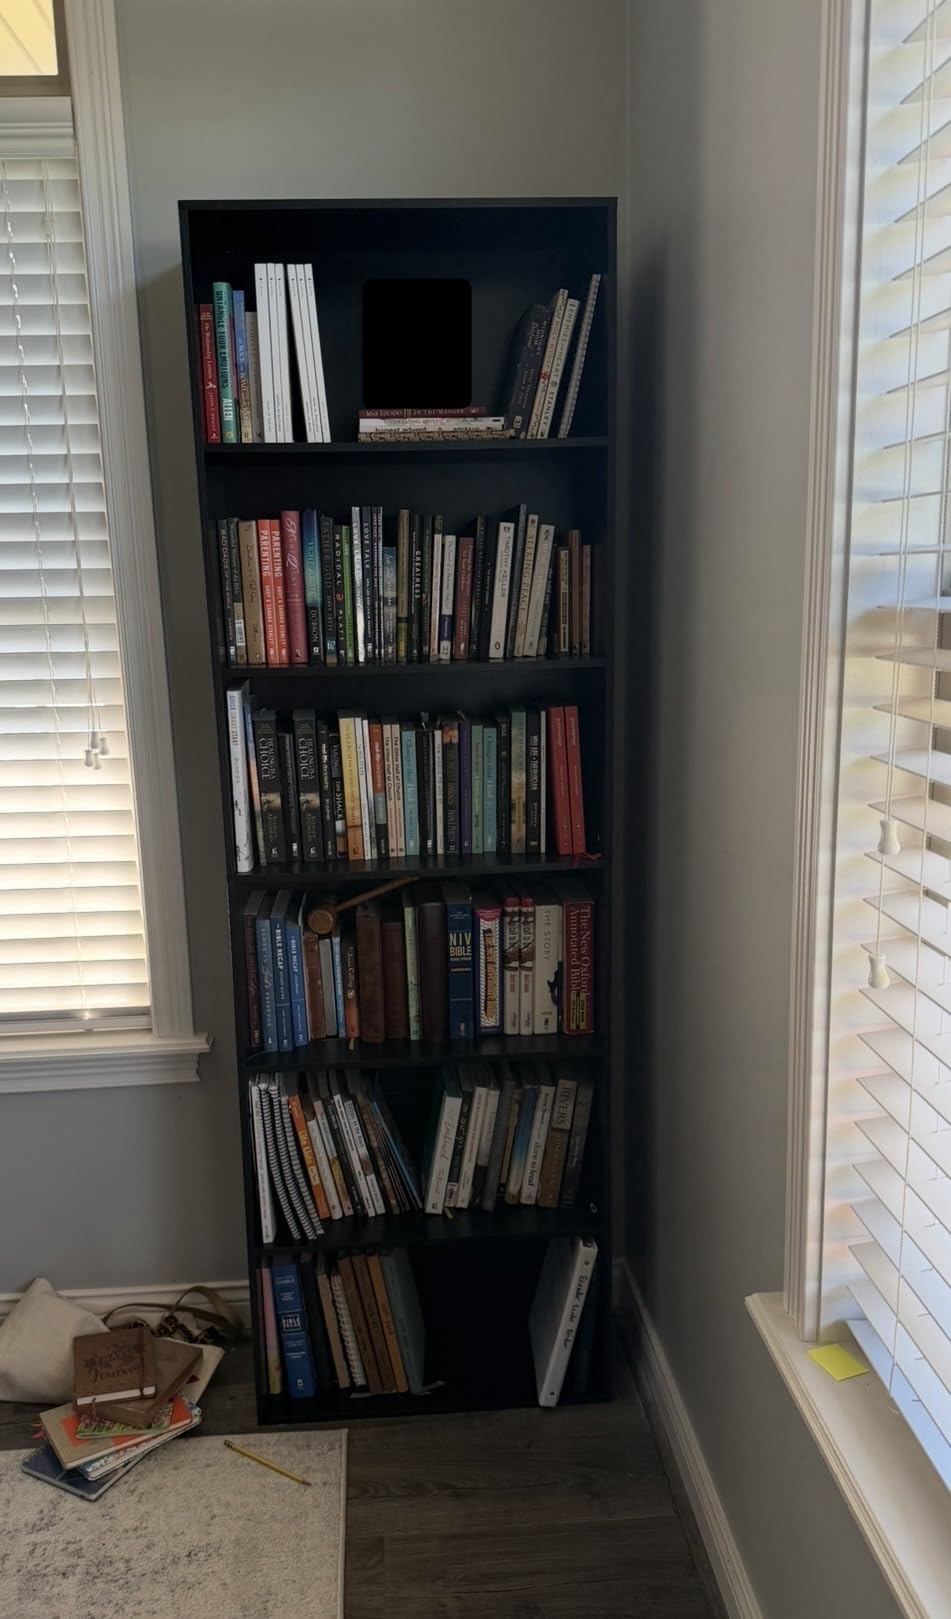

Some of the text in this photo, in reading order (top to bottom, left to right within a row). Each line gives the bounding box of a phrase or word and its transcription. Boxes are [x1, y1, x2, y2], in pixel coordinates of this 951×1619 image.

[215, 291, 229, 389] UNTANGLE YOUR EMOTIONS
[222, 398, 233, 422] ALLEN
[541, 390, 554, 426] STANLEY
[260, 531, 271, 577] PARENTING
[271, 531, 282, 577] PARENTING
[502, 536, 511, 568] TIMOTHY
[500, 570, 508, 598] KELLER
[520, 535, 534, 611] SEEKING PEACE
[311, 609, 319, 643] DOBSON
[259, 737, 271, 781] CHOICE
[267, 738, 276, 764] HEALING
[298, 737, 310, 781] CHOICE
[306, 738, 314, 764] HEALING
[335, 792, 344, 820] SHACK
[581, 906, 591, 929] The
[275, 929, 283, 947] BIBLE
[449, 933, 472, 944] NIV
[543, 910, 551, 961] THE STORY
[569, 907, 580, 966] Annotated
[581, 931, 591, 956] New
[276, 948, 284, 970] RECAP
[449, 947, 472, 957] BIBLE
[557, 1087, 569, 1125] RIVERS
[527, 1169, 539, 1187] lead
